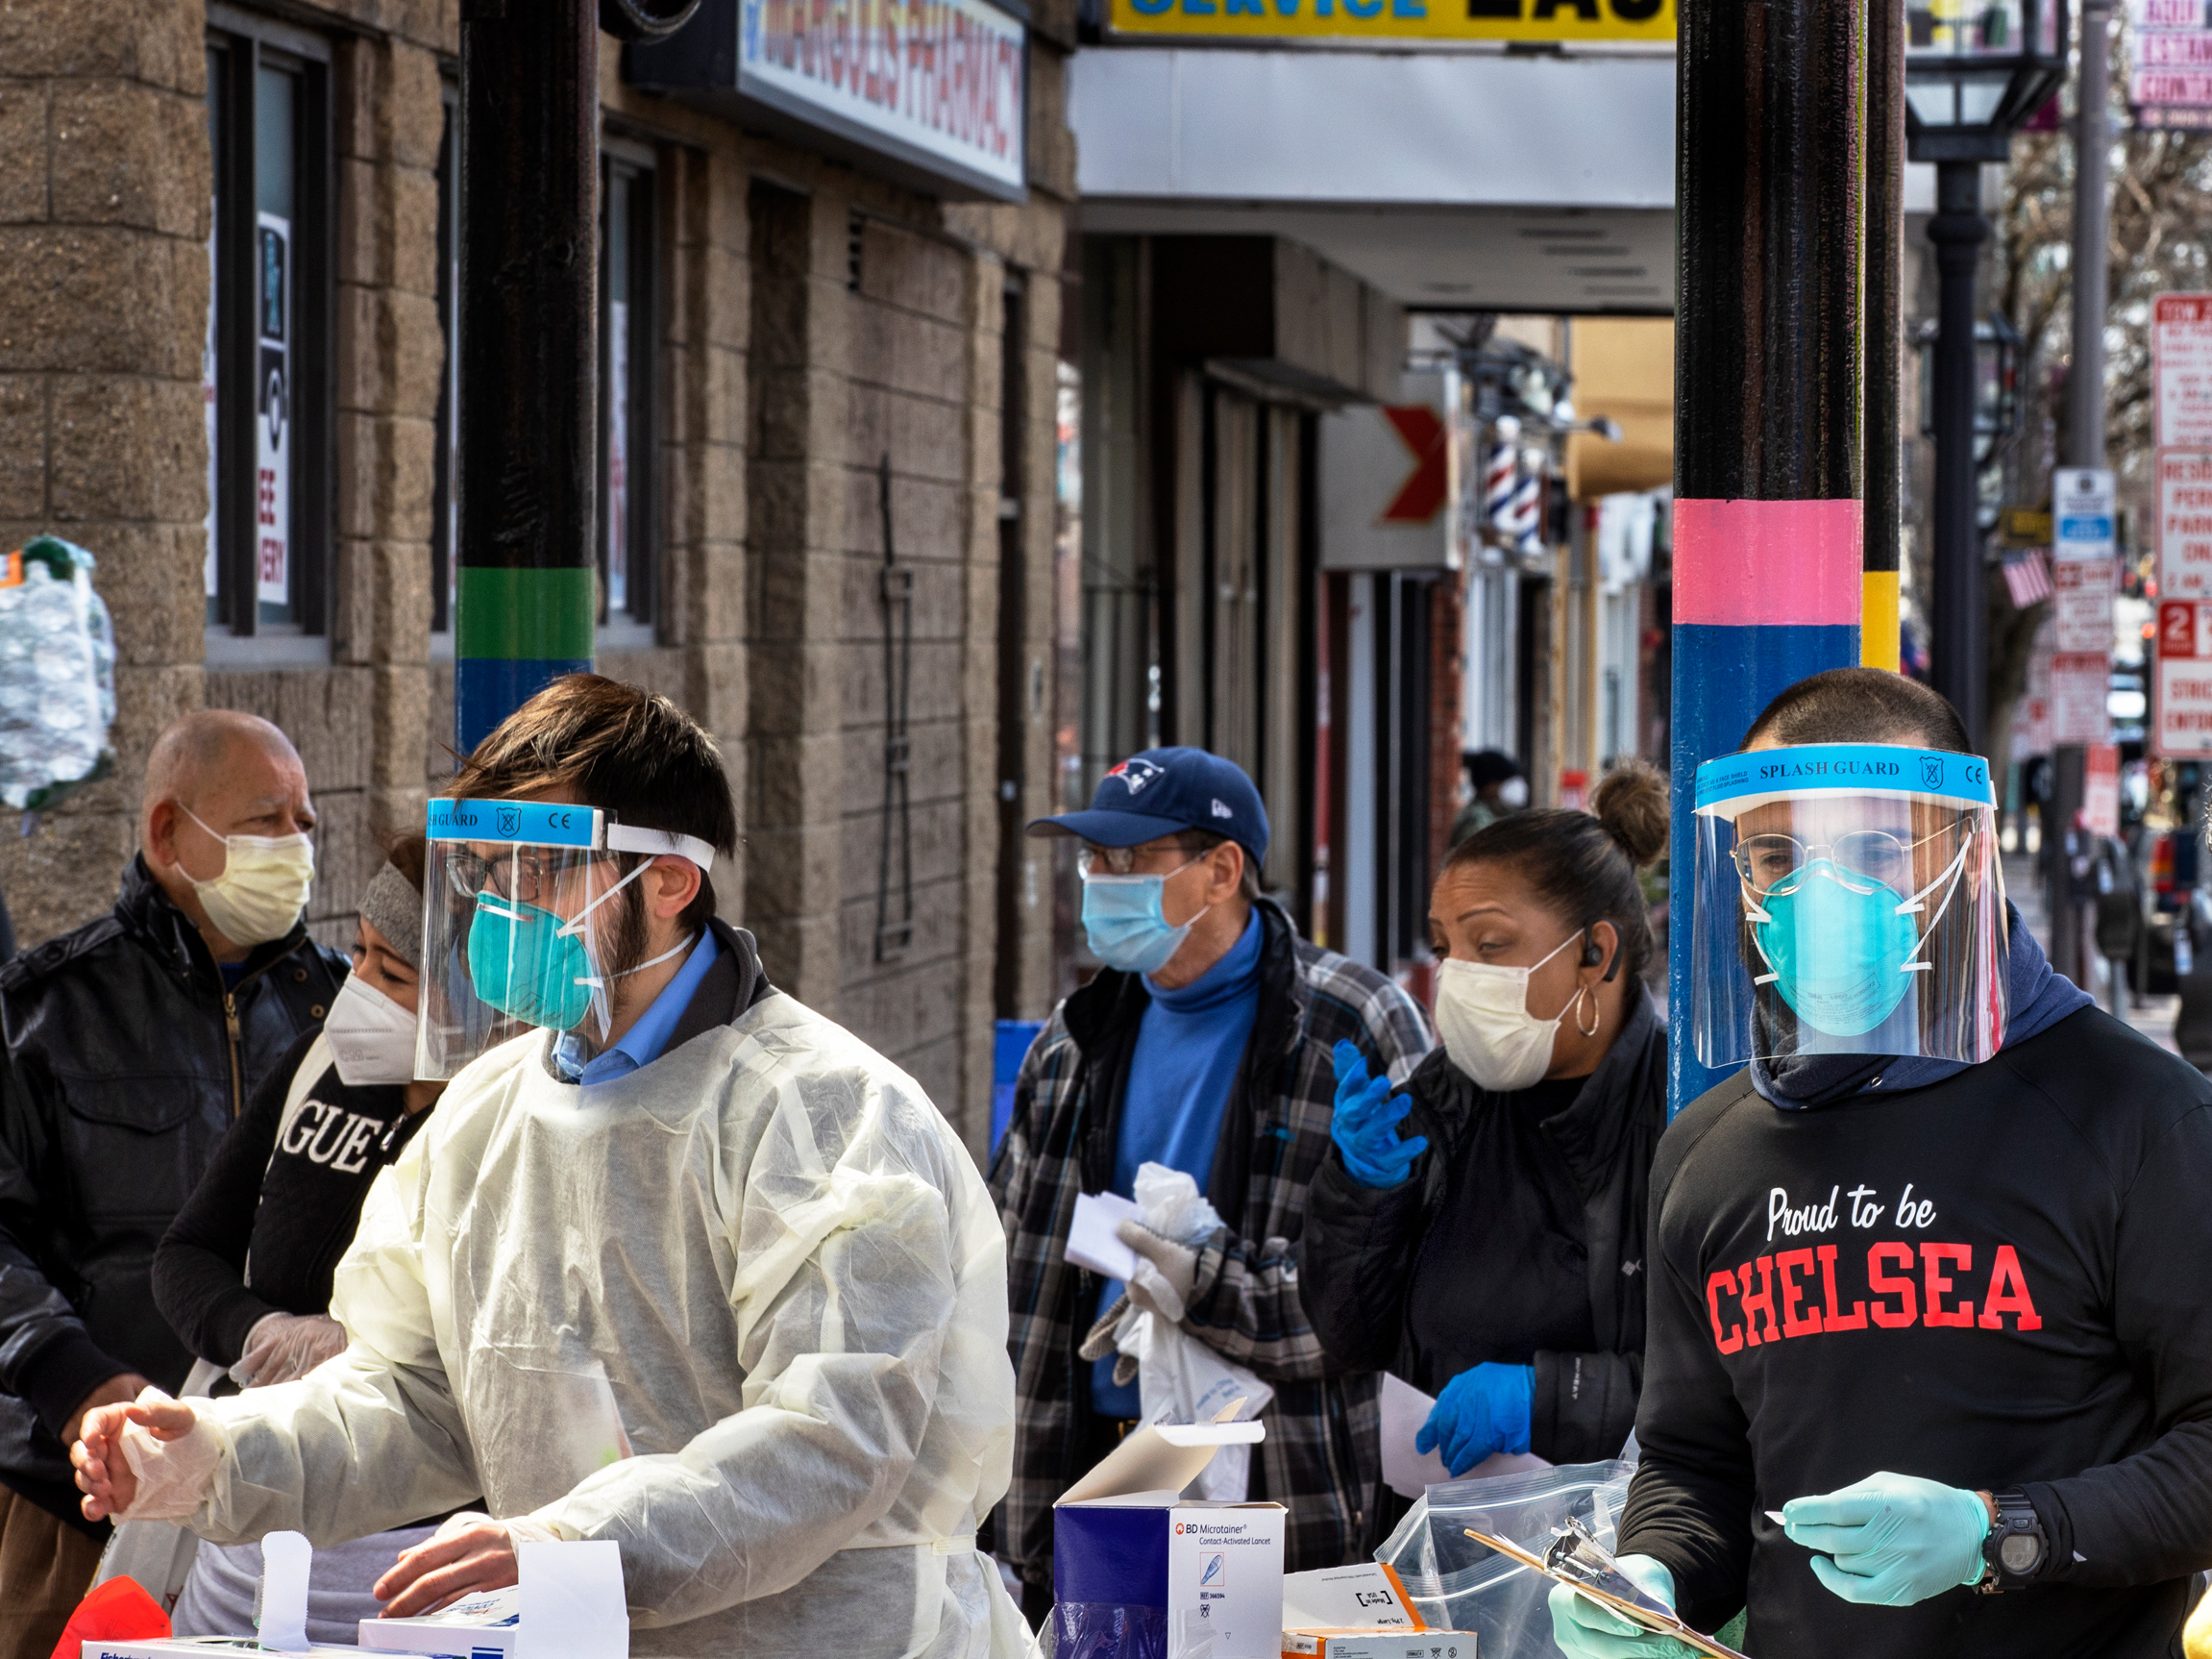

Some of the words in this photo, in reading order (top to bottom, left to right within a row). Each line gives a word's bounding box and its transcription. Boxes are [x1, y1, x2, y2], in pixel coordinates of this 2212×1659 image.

[2166, 606, 2190, 641] 2
[1731, 771, 1748, 780] SHIELD
[1760, 760, 1829, 780] SPLASH
[1832, 760, 1900, 777] GUARD
[1965, 765, 1982, 785] CE
[1723, 777, 1750, 787] SPLASHING
[438, 814, 479, 828] GUARD
[549, 812, 571, 830] CE
[1767, 1184, 1839, 1242] Proud
[1847, 1183, 1884, 1228] to
[1895, 1183, 1936, 1228] be
[1707, 1242, 2042, 1355] CHELSEA
[1186, 1523, 1198, 1534] BD
